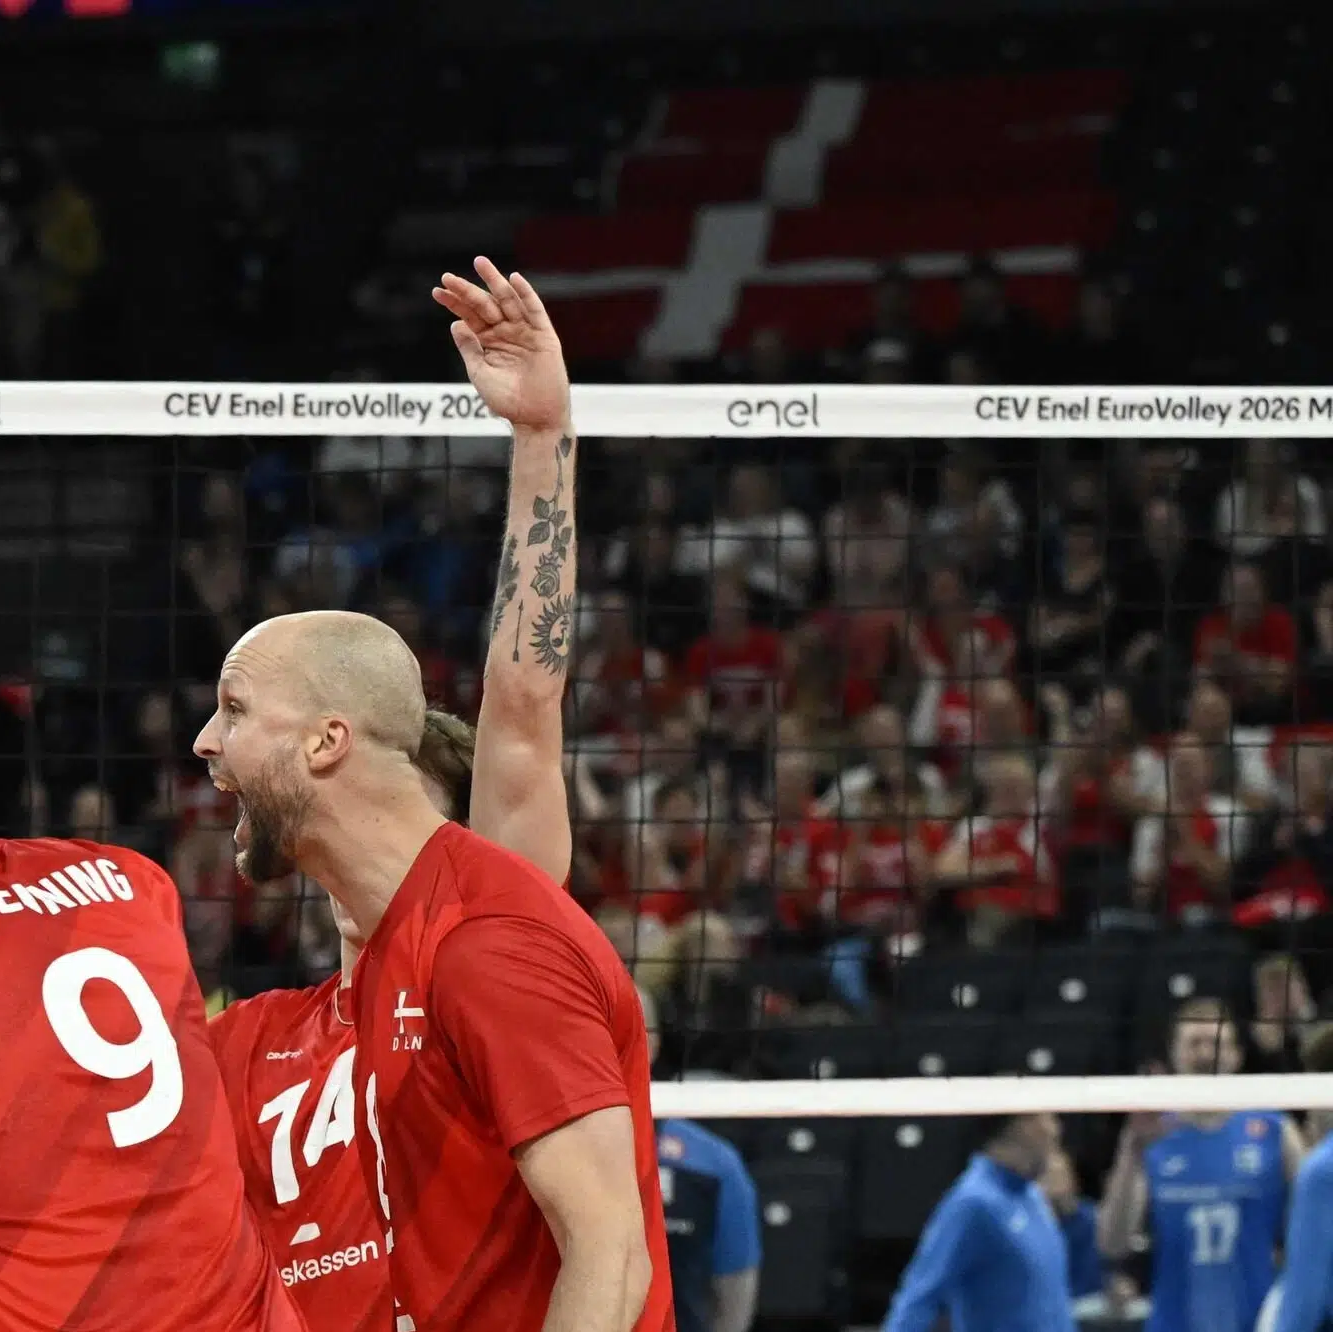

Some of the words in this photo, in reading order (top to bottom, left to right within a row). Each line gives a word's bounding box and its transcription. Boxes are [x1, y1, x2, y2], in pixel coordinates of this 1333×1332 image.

[164, 392, 221, 417] CEV
[230, 392, 283, 417] Enel
[292, 393, 431, 424] EuroVolley
[441, 393, 489, 418] 202
[726, 393, 818, 427] enel
[975, 396, 1029, 420] CEV
[1037, 396, 1089, 420] Enel
[1097, 396, 1232, 426] EuroVolley
[1239, 396, 1300, 420] 2026
[41, 947, 185, 1148] 9
[257, 1044, 357, 1205] 14
[278, 1240, 380, 1287] skassen
